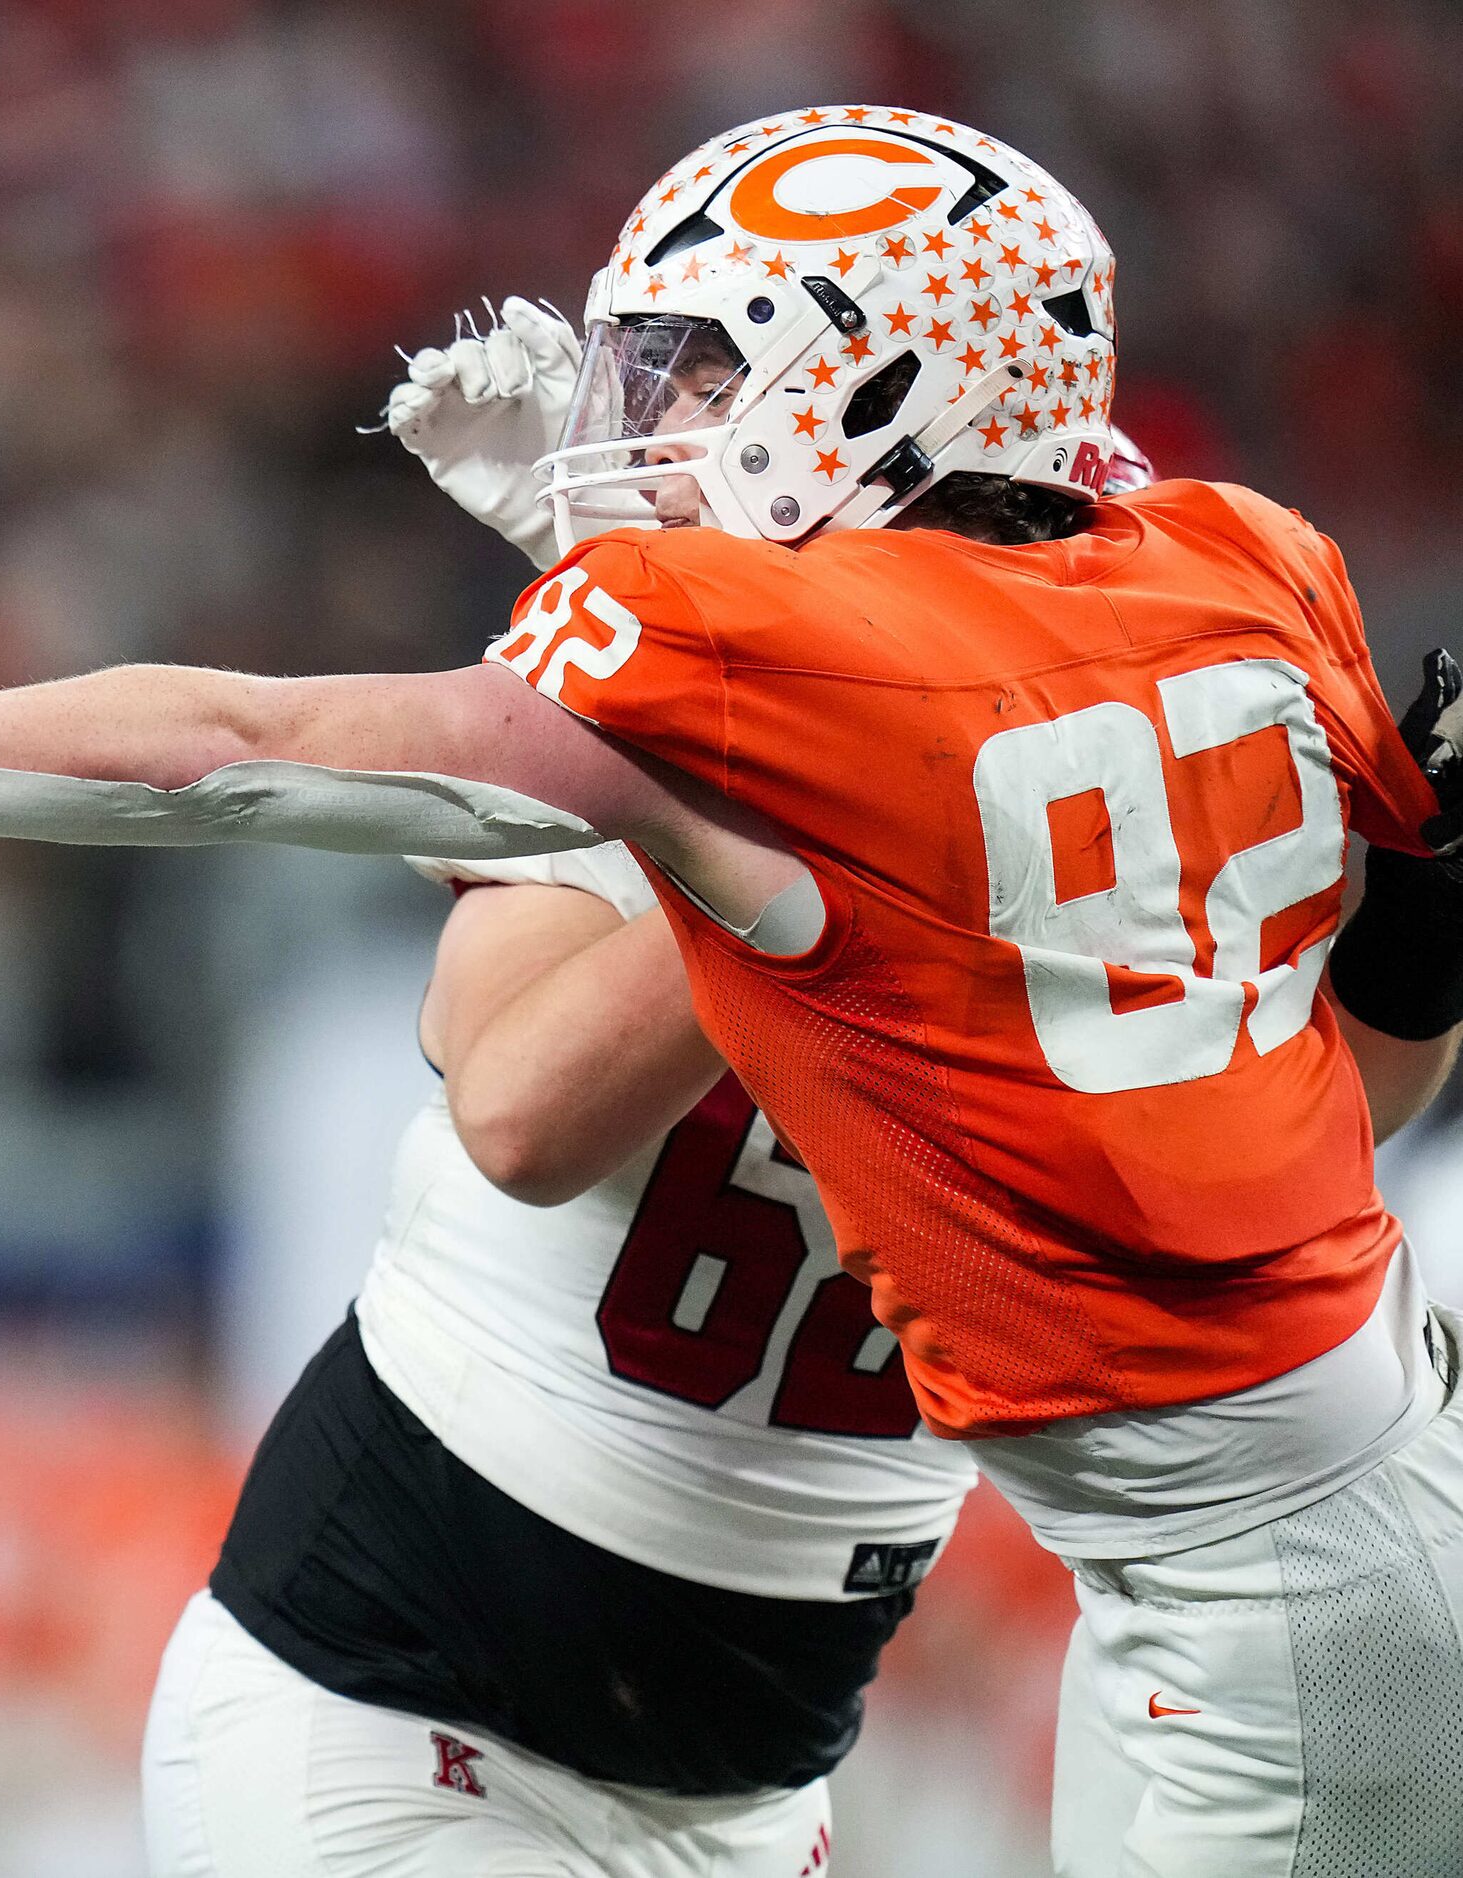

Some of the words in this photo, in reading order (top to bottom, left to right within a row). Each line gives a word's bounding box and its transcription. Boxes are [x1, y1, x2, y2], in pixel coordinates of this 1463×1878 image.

[485, 566, 642, 702] 82
[973, 658, 1344, 1094] 82
[430, 1730, 486, 1799] K
